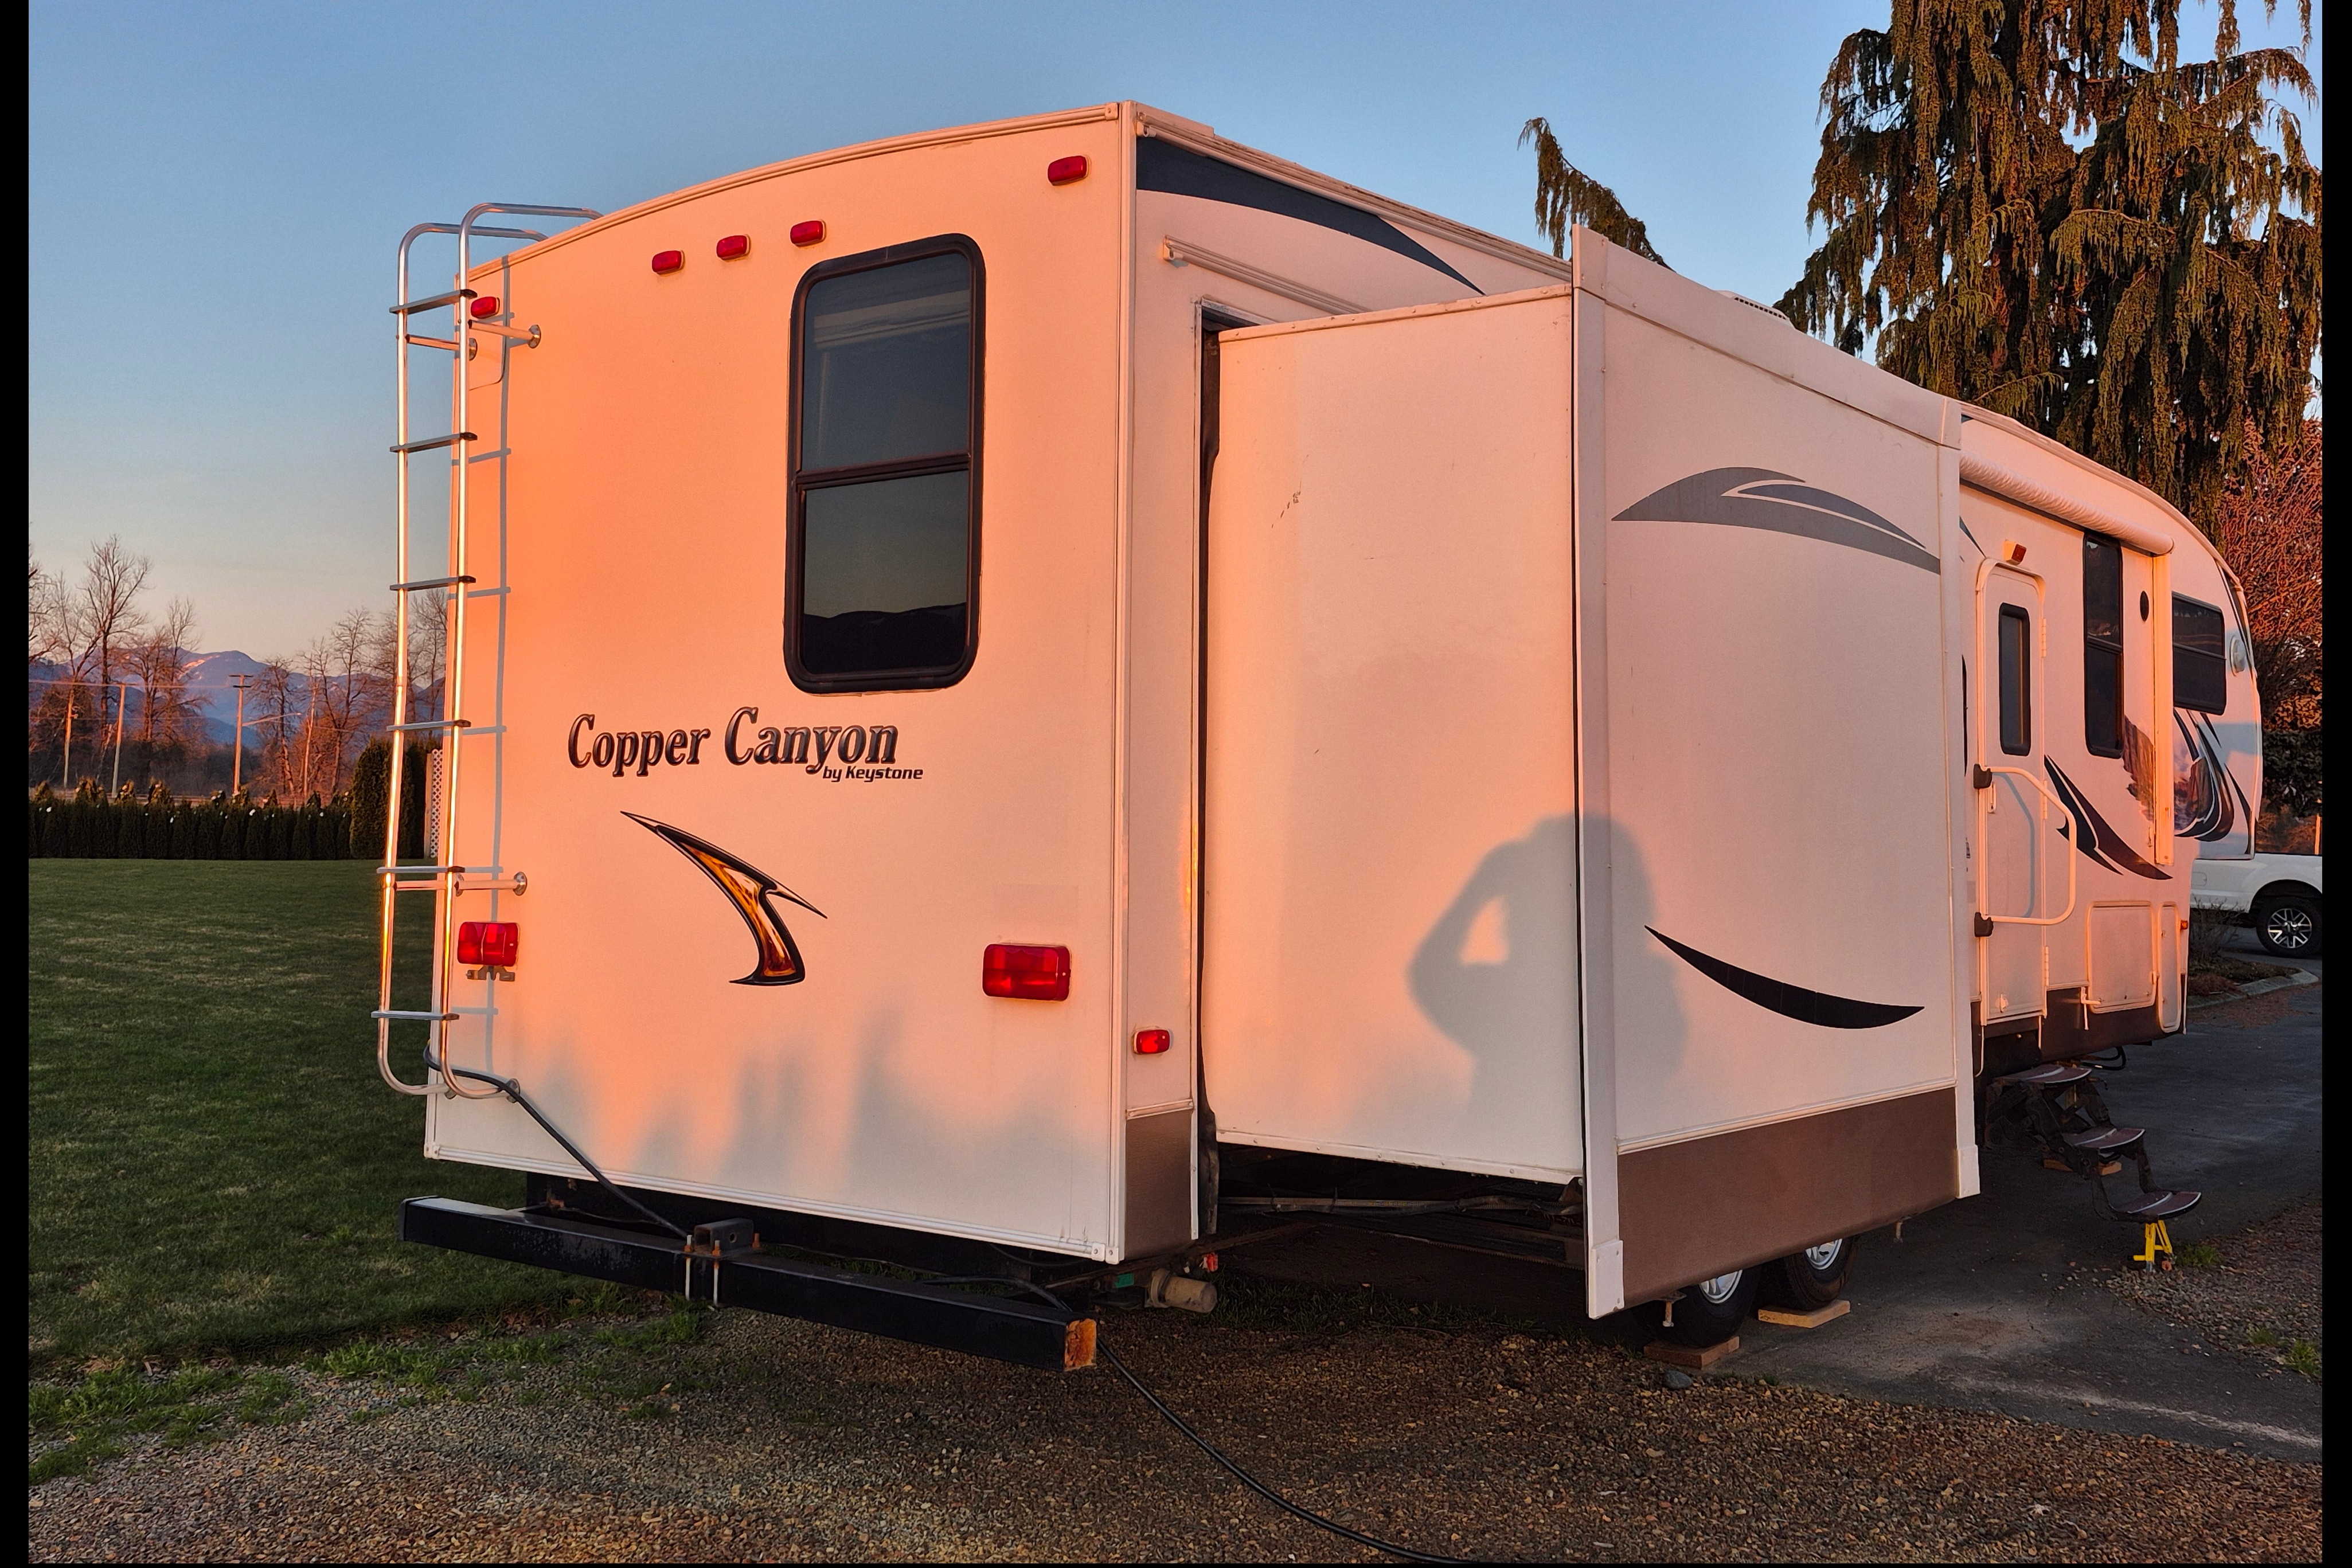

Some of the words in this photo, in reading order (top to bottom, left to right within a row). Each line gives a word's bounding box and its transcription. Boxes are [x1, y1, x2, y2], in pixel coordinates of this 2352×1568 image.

[568, 713, 711, 777] Copper
[724, 706, 898, 775] Canyon
[822, 765, 842, 783] by
[845, 765, 924, 783] Keystone
